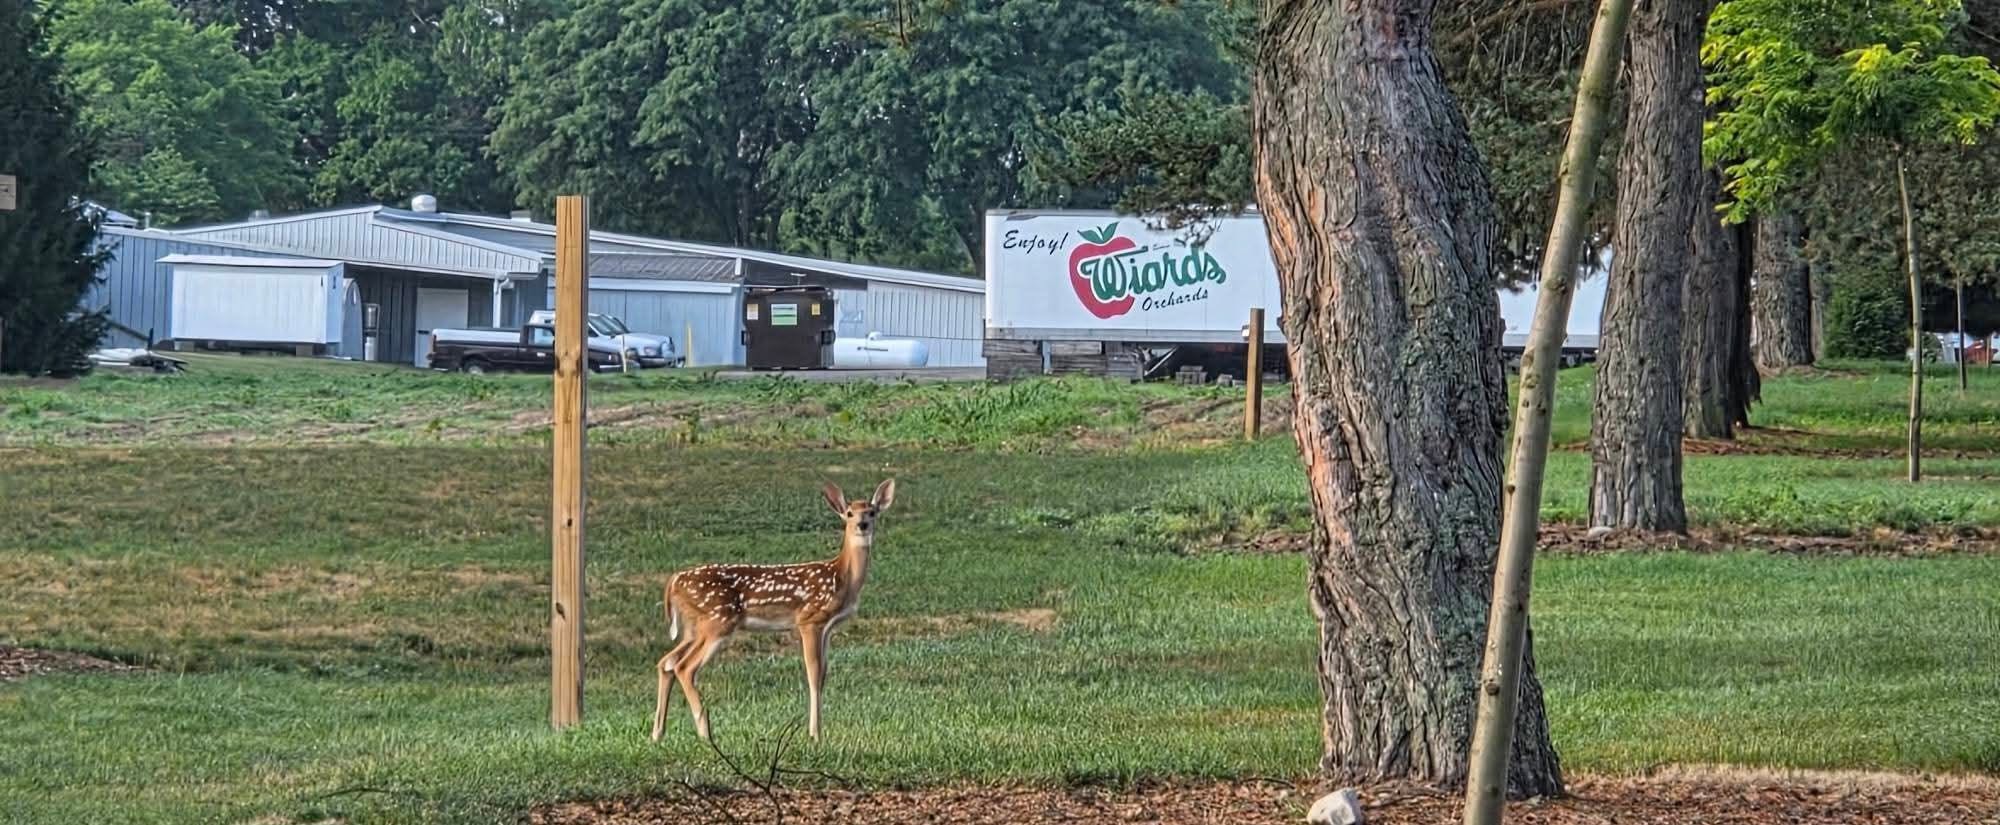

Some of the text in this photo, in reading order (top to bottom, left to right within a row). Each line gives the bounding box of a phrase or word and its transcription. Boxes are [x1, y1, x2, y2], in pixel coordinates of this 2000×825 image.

[1003, 229, 1068, 255] Enjoy!
[1080, 244, 1227, 301] Wiards
[1142, 287, 1209, 312] Orchards
